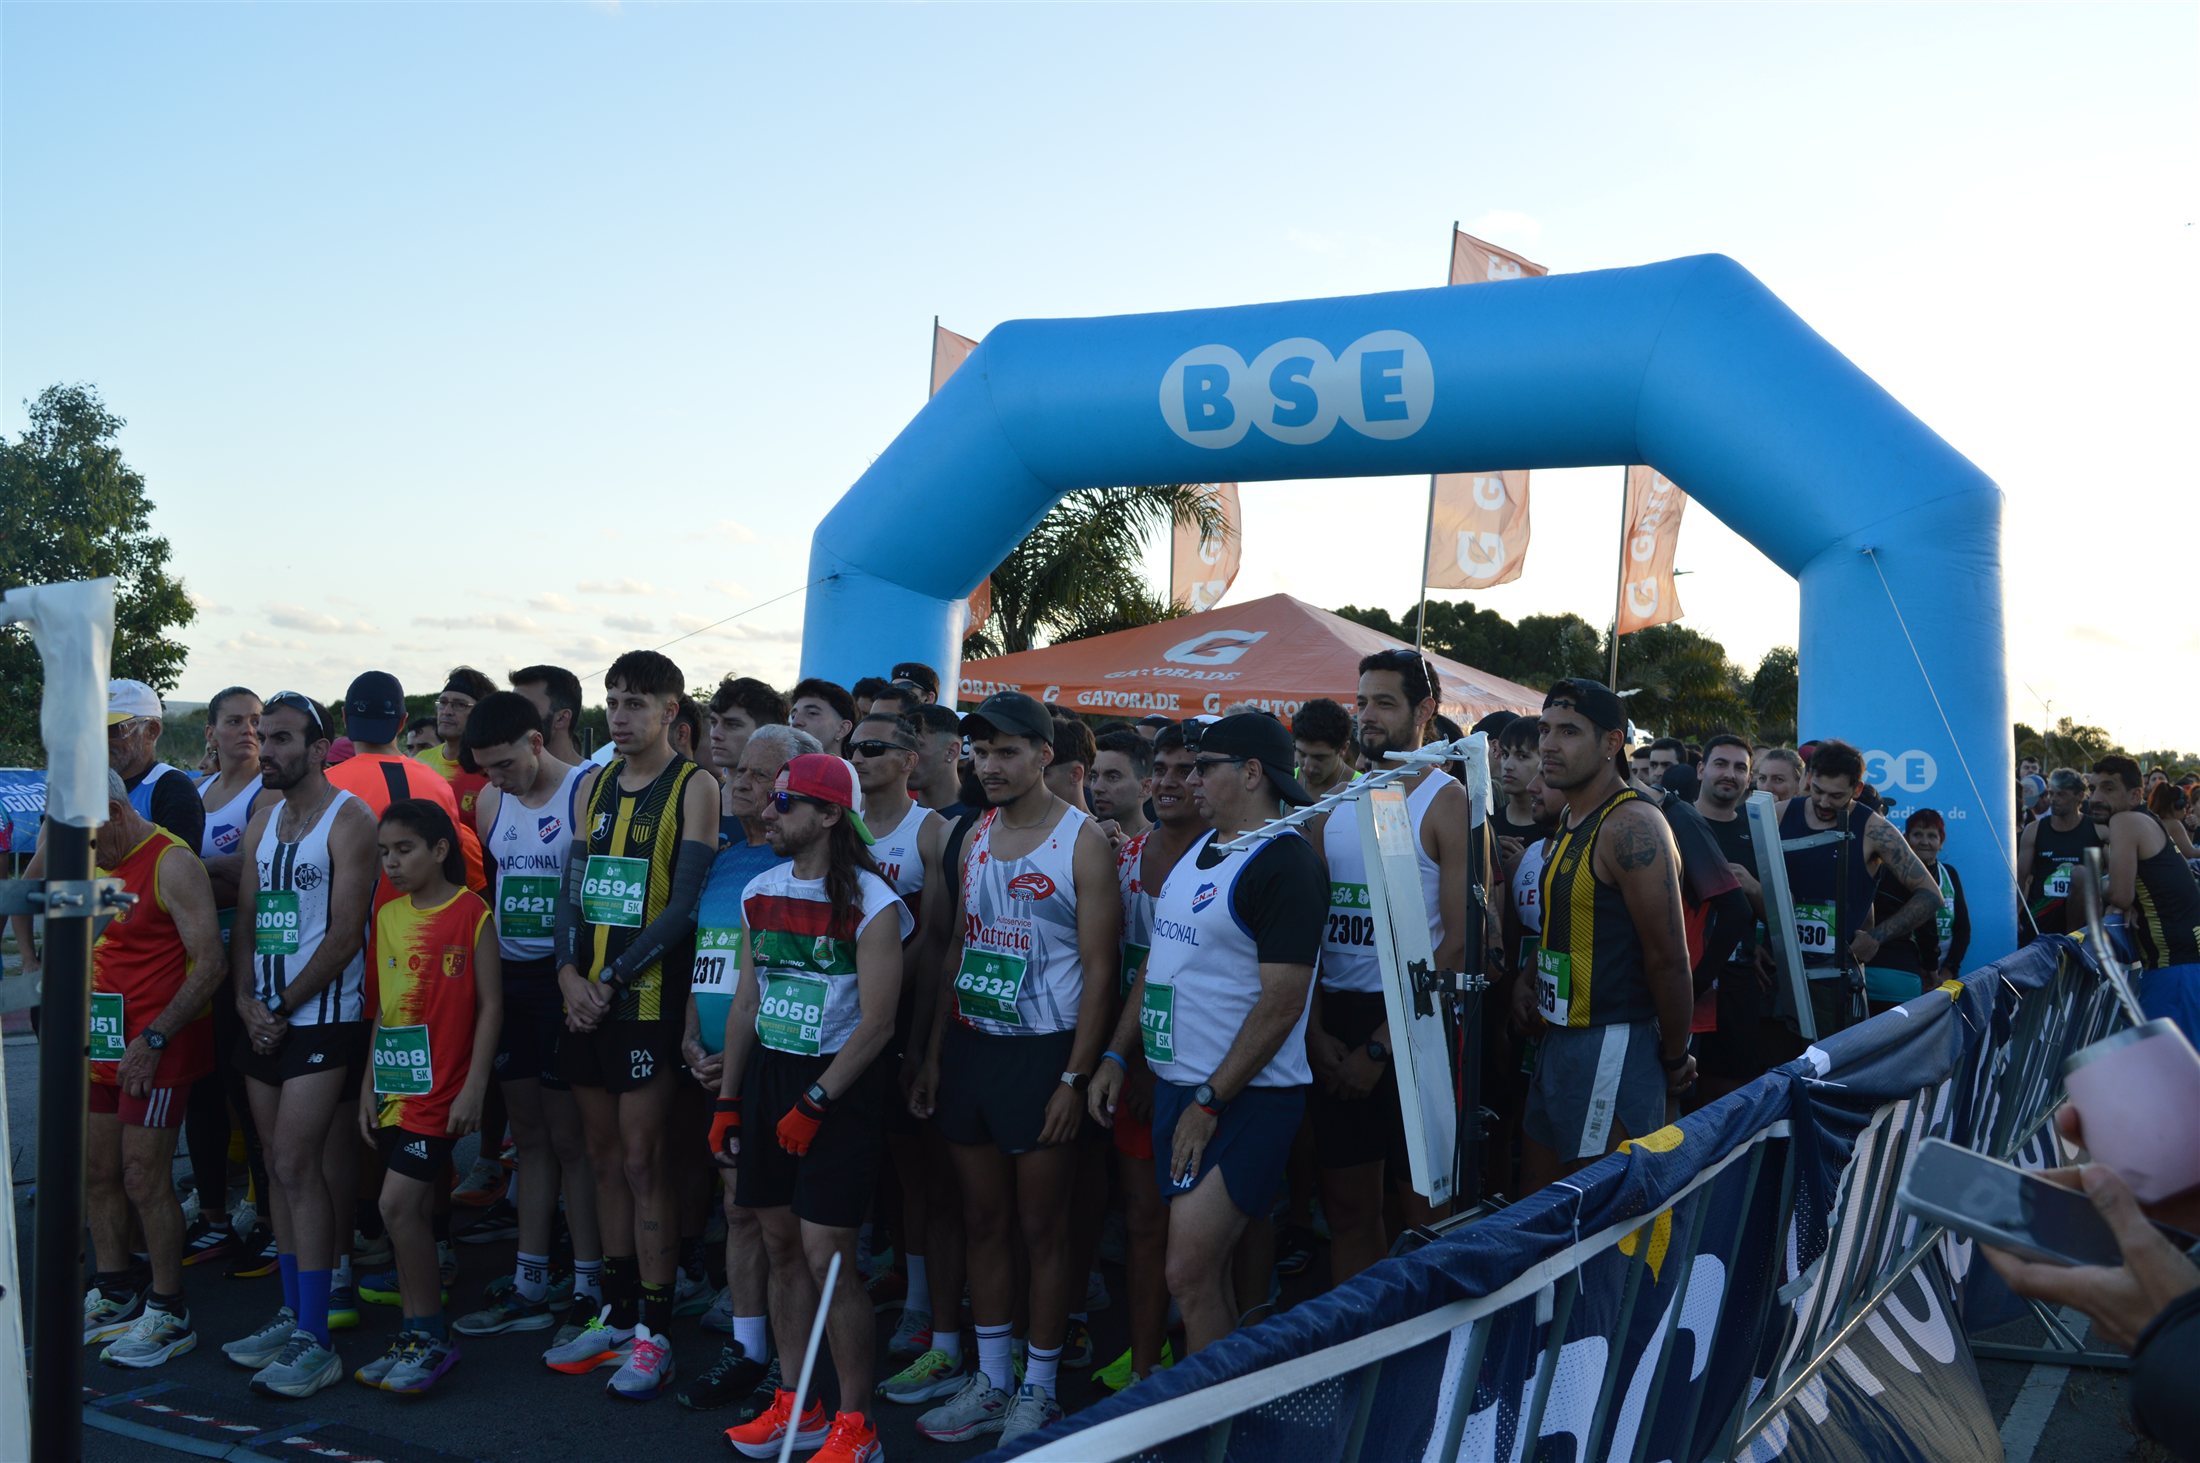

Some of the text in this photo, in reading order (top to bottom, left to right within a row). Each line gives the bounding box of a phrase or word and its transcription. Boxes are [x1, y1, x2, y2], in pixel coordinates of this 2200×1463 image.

[1180, 346, 1412, 435] BSE
[1077, 690, 1180, 711] GATORADE
[1866, 757, 1926, 785] SE
[1947, 806, 1967, 819] da
[499, 854, 560, 870] NACIONAL
[585, 878, 642, 899] 6594
[504, 896, 555, 913] 6421
[1518, 889, 1537, 907] LE
[627, 902, 640, 913] 5K
[256, 911, 298, 929] 6009
[996, 915, 1032, 928] Autoservice
[286, 931, 297, 942] 5K
[965, 912, 1031, 951] Patricia
[1152, 917, 1200, 947] NACIONAL
[1328, 913, 1375, 947] 2302
[693, 956, 726, 985] 2317
[779, 959, 806, 968] RHINO
[958, 973, 1016, 999] 6332
[762, 996, 820, 1024] 6058
[90, 1016, 117, 1034] 51
[804, 1027, 817, 1040] 5K
[1159, 1034, 1169, 1047] 5K
[374, 1048, 427, 1067] 6088
[416, 1069, 429, 1080] 5K
[523, 1267, 542, 1284] 28
